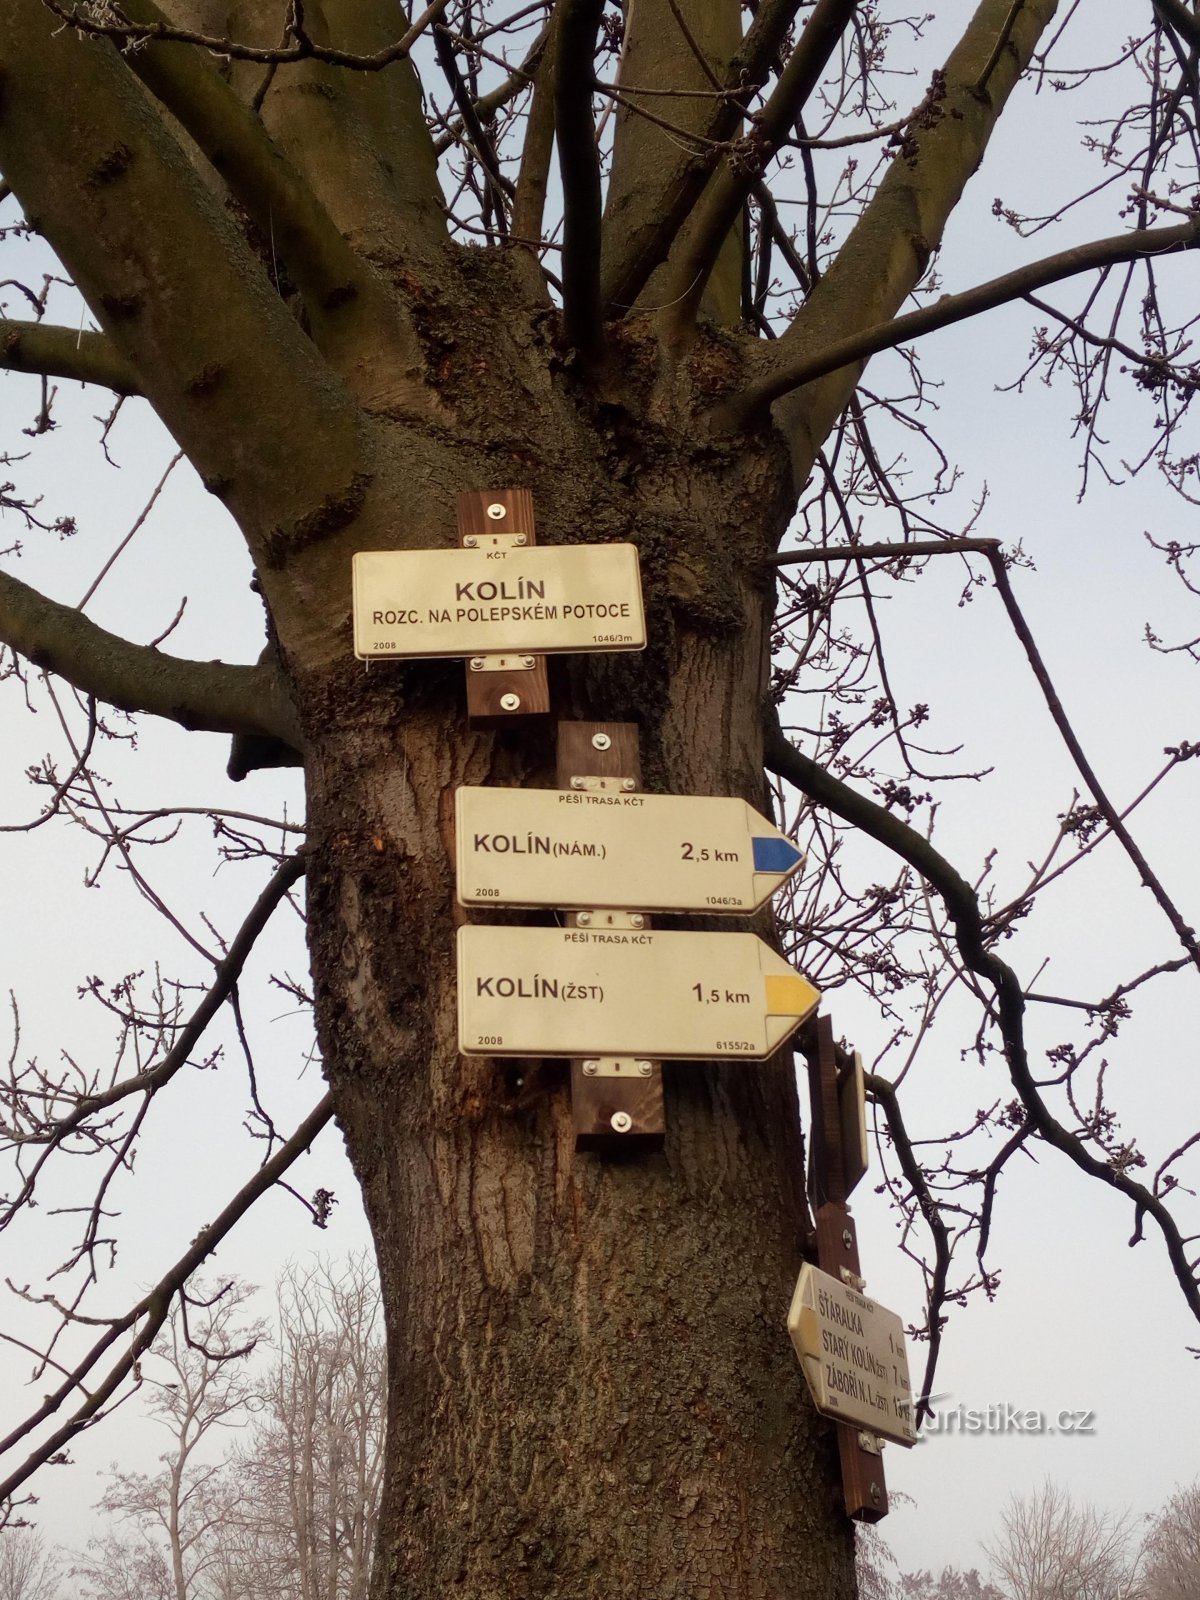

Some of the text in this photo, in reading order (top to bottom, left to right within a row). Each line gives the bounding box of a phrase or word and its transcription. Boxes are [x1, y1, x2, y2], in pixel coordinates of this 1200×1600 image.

[486, 551, 507, 559] KČT
[455, 576, 545, 601] KOLÍN
[373, 602, 630, 625] ROZC. NA POLEPSKÉM POTOCE
[592, 634, 633, 643] 1046/3m
[373, 642, 396, 650] 2008
[586, 796, 622, 806] TRASA
[624, 797, 645, 807] KČT
[474, 832, 739, 862] KOLÍN (NÁM.) 2,5 km
[475, 888, 500, 897] 2008
[706, 896, 743, 906] 1046/3a
[592, 934, 629, 944] TRASA
[631, 934, 653, 944] KČT
[476, 974, 750, 1004] KOLÍN (ŽST) 1,5 km
[477, 1036, 503, 1045] 2008
[716, 1041, 755, 1051] 6155/2a
[822, 1329, 849, 1362] STARÝ
[850, 1346, 876, 1376] KOLÍN
[825, 1361, 858, 1400] ZÁBOŘÍ
